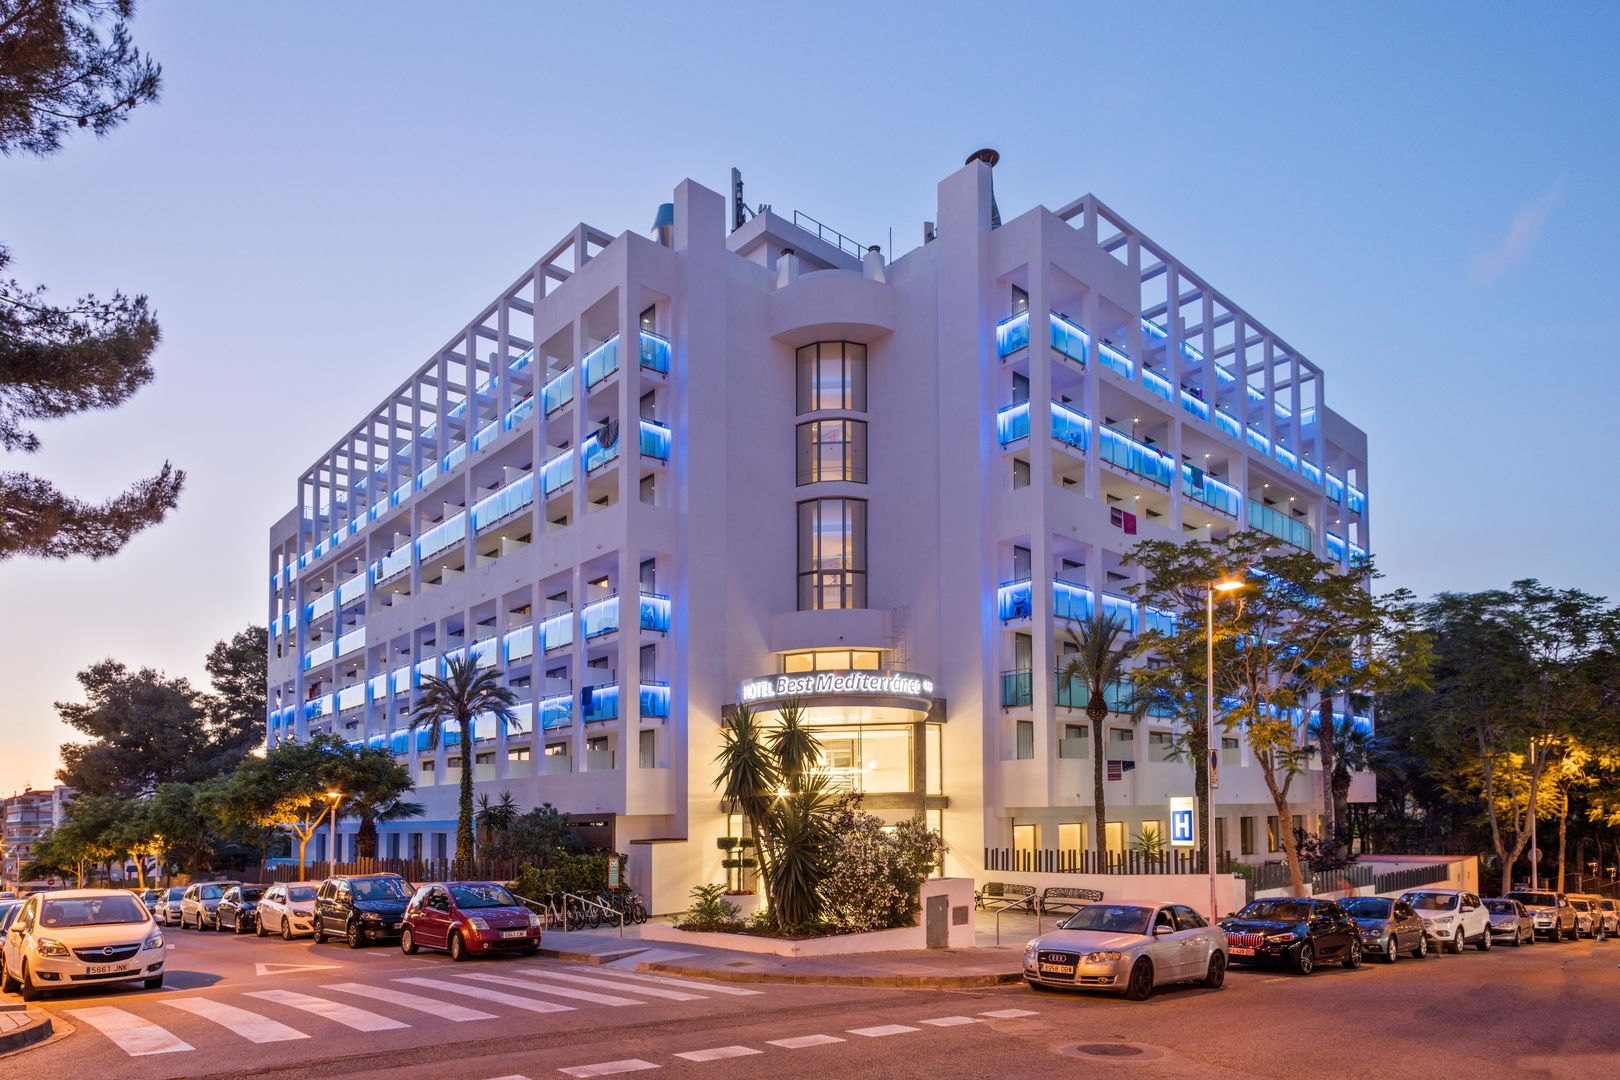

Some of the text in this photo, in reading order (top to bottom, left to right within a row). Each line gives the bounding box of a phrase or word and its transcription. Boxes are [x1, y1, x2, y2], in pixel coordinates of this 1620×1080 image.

[743, 680, 775, 700] HOTEL
[776, 676, 815, 695] Best
[1175, 813, 1190, 838] H
[91, 966, 111, 974] 5661
